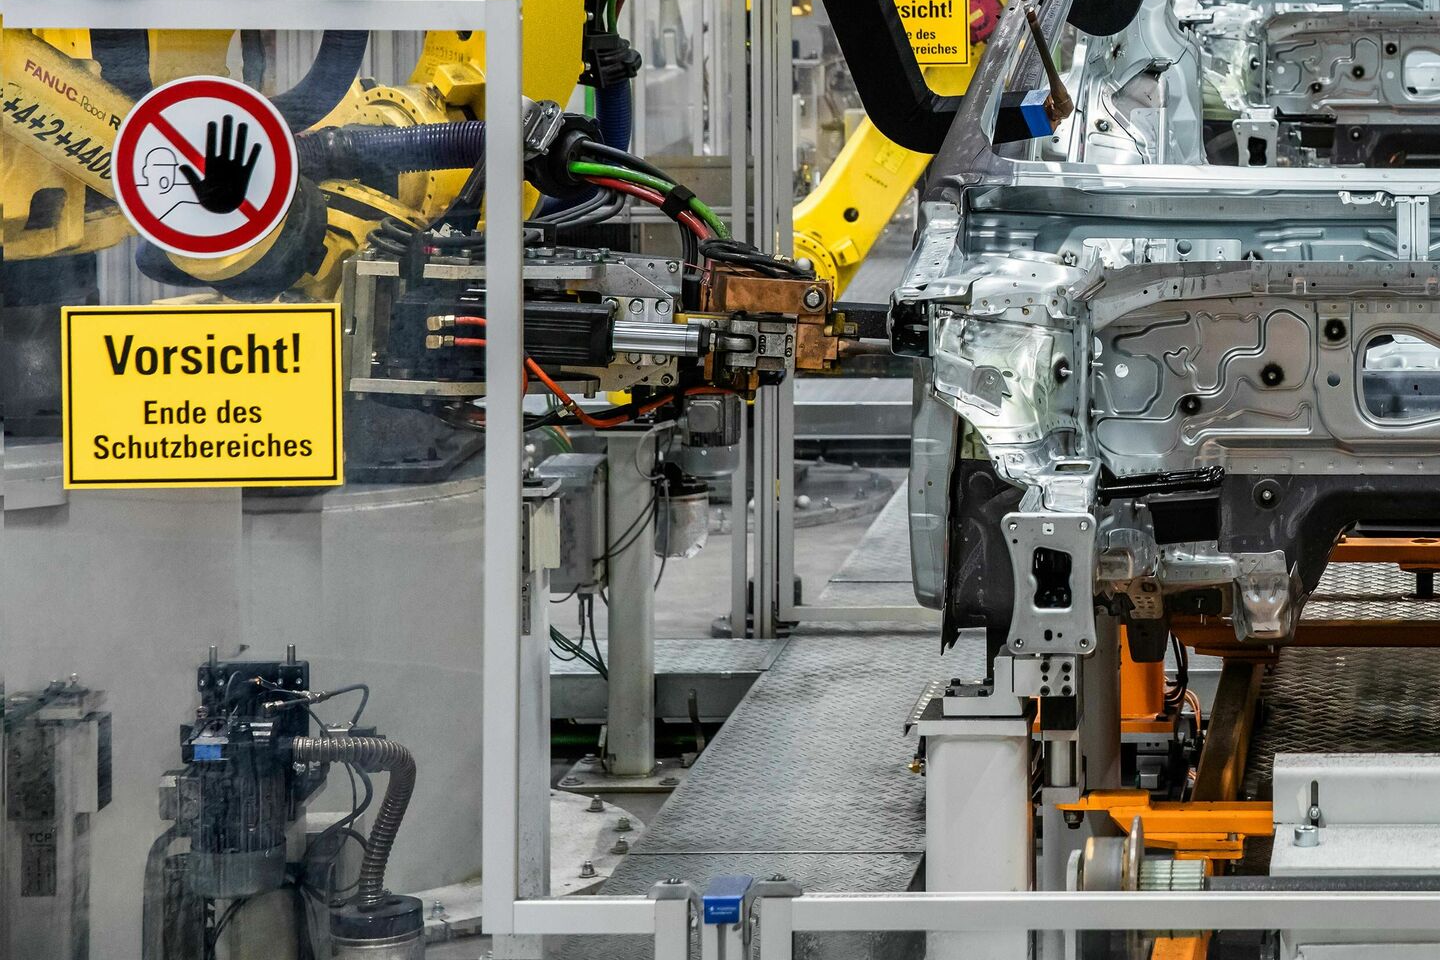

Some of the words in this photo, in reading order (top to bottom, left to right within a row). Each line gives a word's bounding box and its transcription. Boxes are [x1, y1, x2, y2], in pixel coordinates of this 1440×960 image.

[897, 0, 952, 18] sicht!
[916, 29, 936, 40] des
[24, 59, 78, 101] FANUC
[80, 96, 107, 121] Robot
[104, 333, 300, 376] Vorsicht!
[144, 400, 207, 424] Ende
[217, 400, 262, 424] des
[93, 433, 313, 459] Schutzbereiches
[29, 832, 52, 843] TCP
